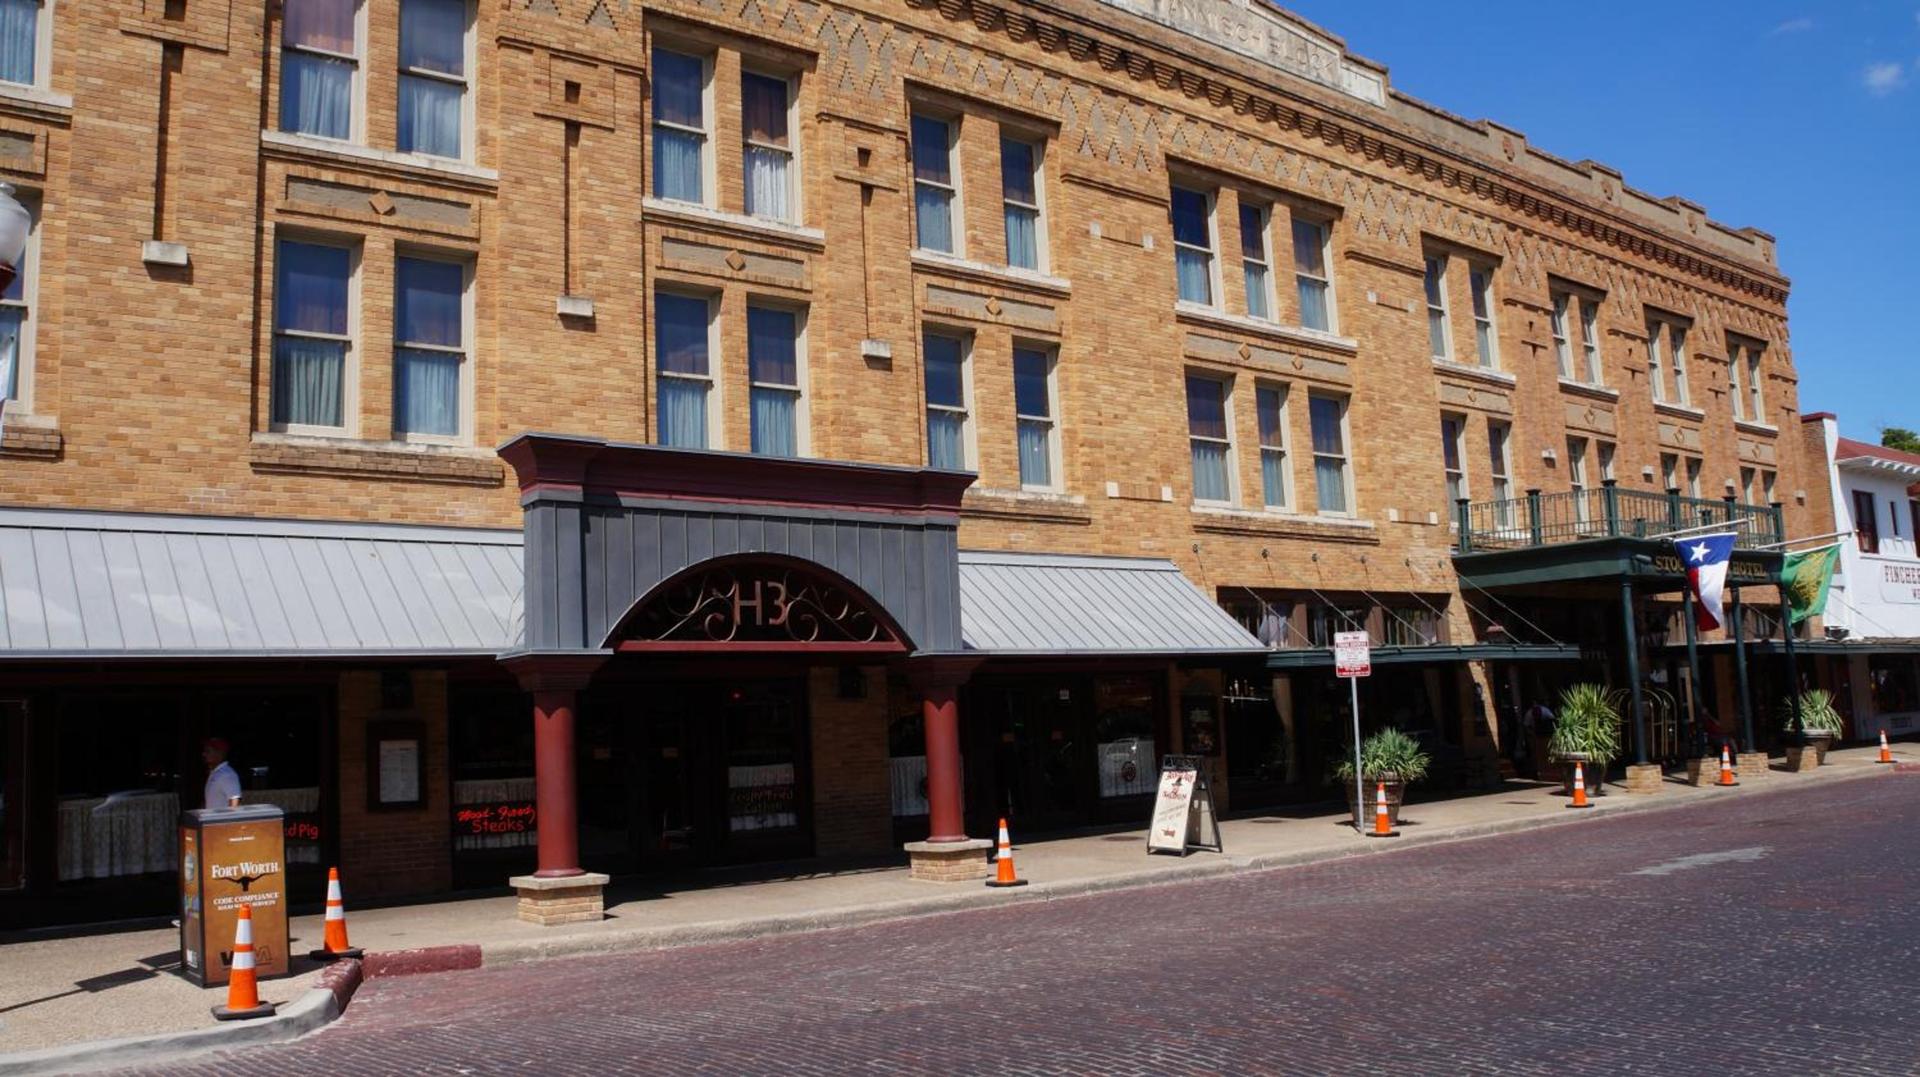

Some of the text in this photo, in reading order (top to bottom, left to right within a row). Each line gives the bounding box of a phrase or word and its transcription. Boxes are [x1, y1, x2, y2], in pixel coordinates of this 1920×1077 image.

[1732, 560, 1767, 578] HOTEL
[733, 580, 787, 626] H3
[298, 823, 319, 840] Pig
[472, 817, 526, 833] Steaks
[211, 861, 279, 878] FORT WORTH
[212, 896, 234, 905] CODE
